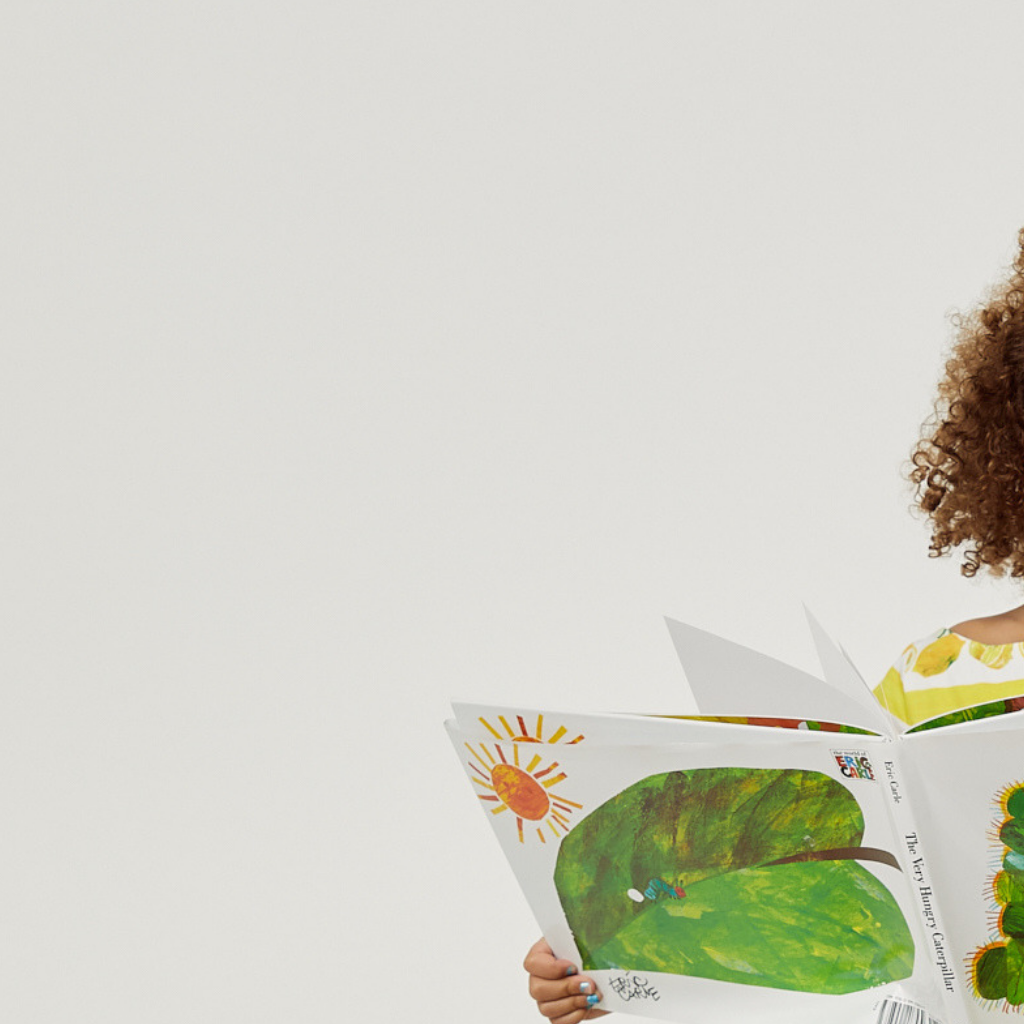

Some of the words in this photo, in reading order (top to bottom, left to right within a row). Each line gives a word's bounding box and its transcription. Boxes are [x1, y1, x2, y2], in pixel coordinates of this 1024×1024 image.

[835, 755, 871, 769] ERIC
[884, 761, 895, 779] Eric
[889, 781, 902, 804] Carle
[905, 832, 919, 855] The
[912, 857, 926, 884] Very
[919, 886, 938, 930] Hungry
[931, 932, 956, 993] Caterpillar
